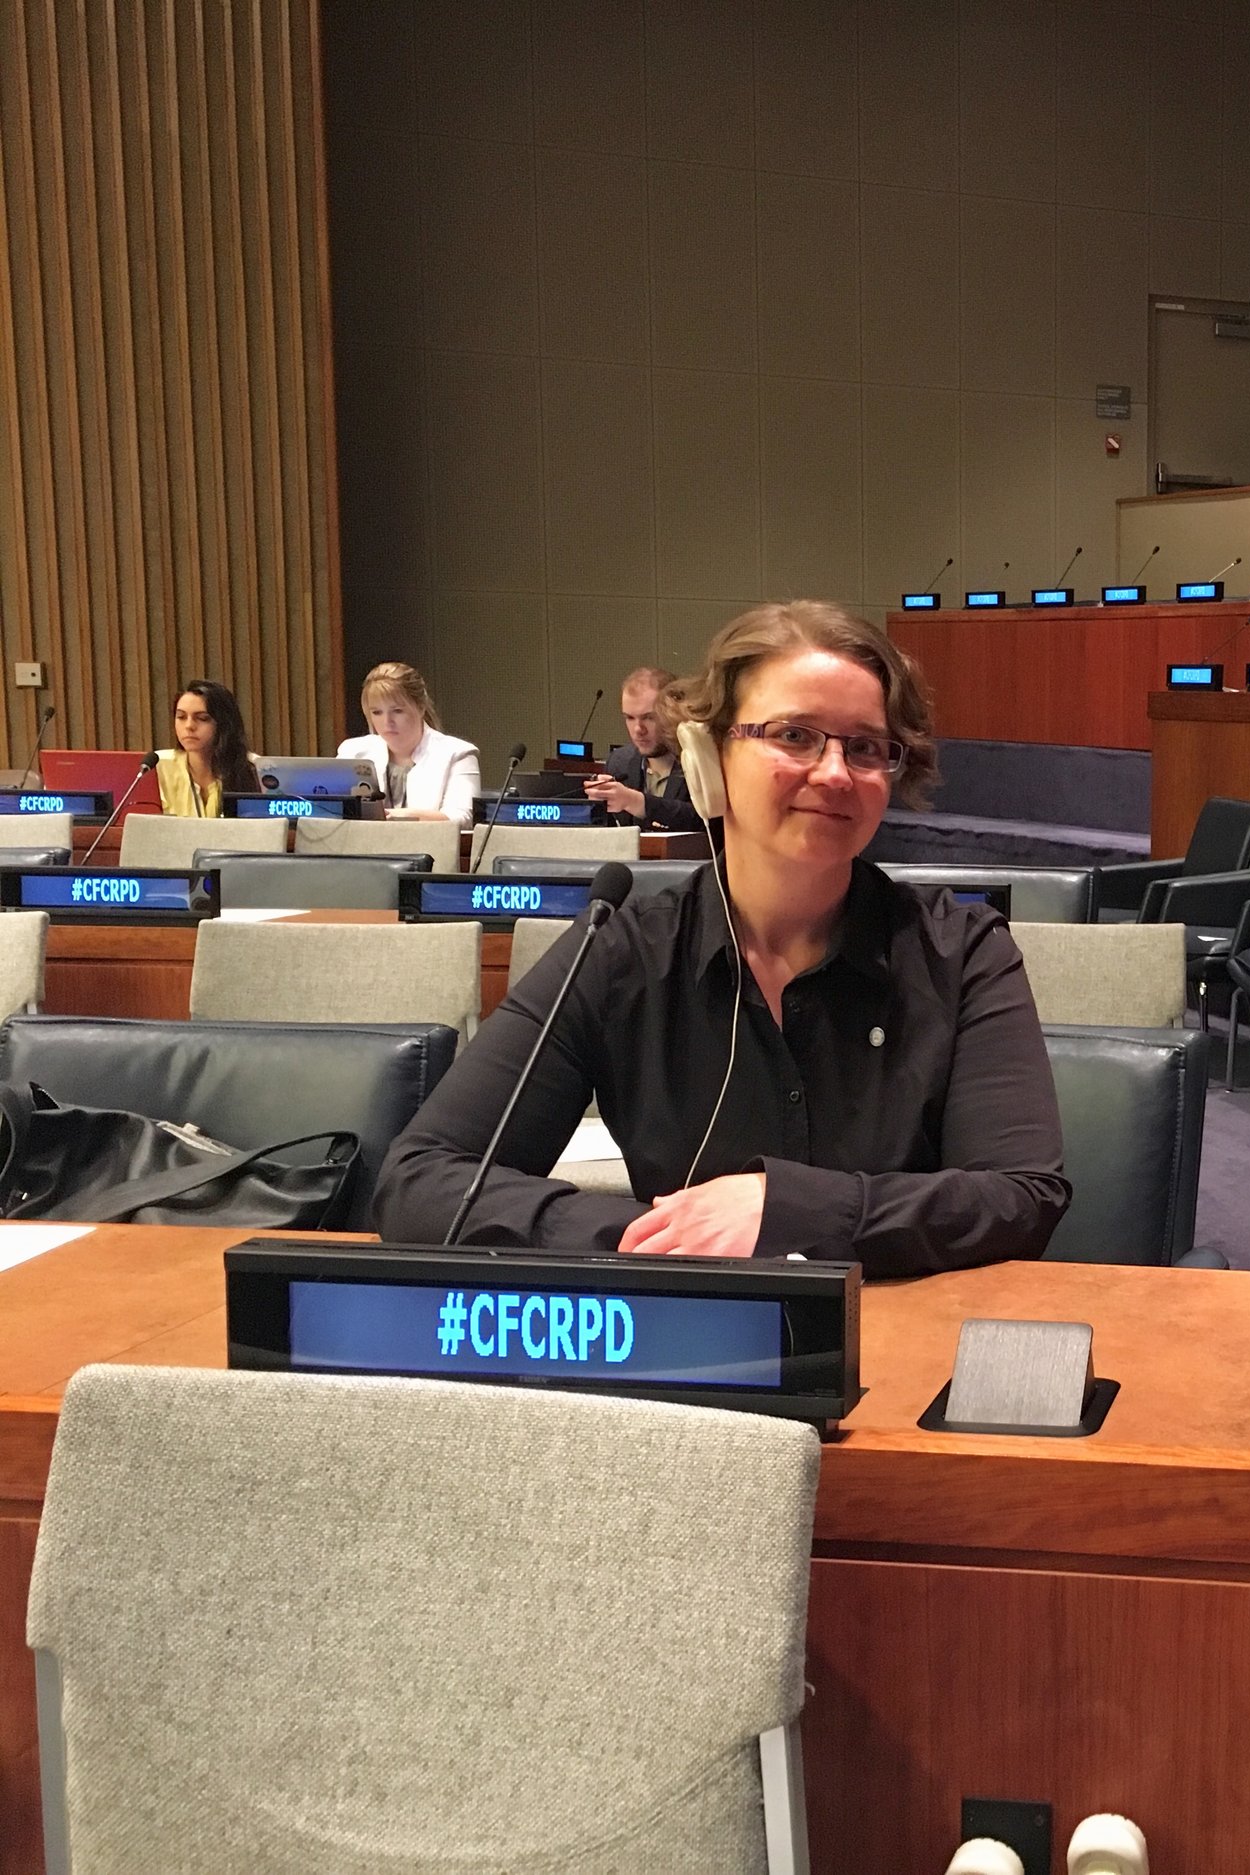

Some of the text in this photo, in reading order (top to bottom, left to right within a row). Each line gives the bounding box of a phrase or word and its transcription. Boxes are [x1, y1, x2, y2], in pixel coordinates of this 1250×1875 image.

[19, 796, 64, 813] #CFCRPD
[268, 800, 312, 817] #CFCRPD
[517, 804, 560, 821] #CFCRPD
[72, 878, 140, 902] #CFCRPD
[472, 886, 540, 910] #CFCRPD
[437, 1292, 634, 1363] #CFCRPD
